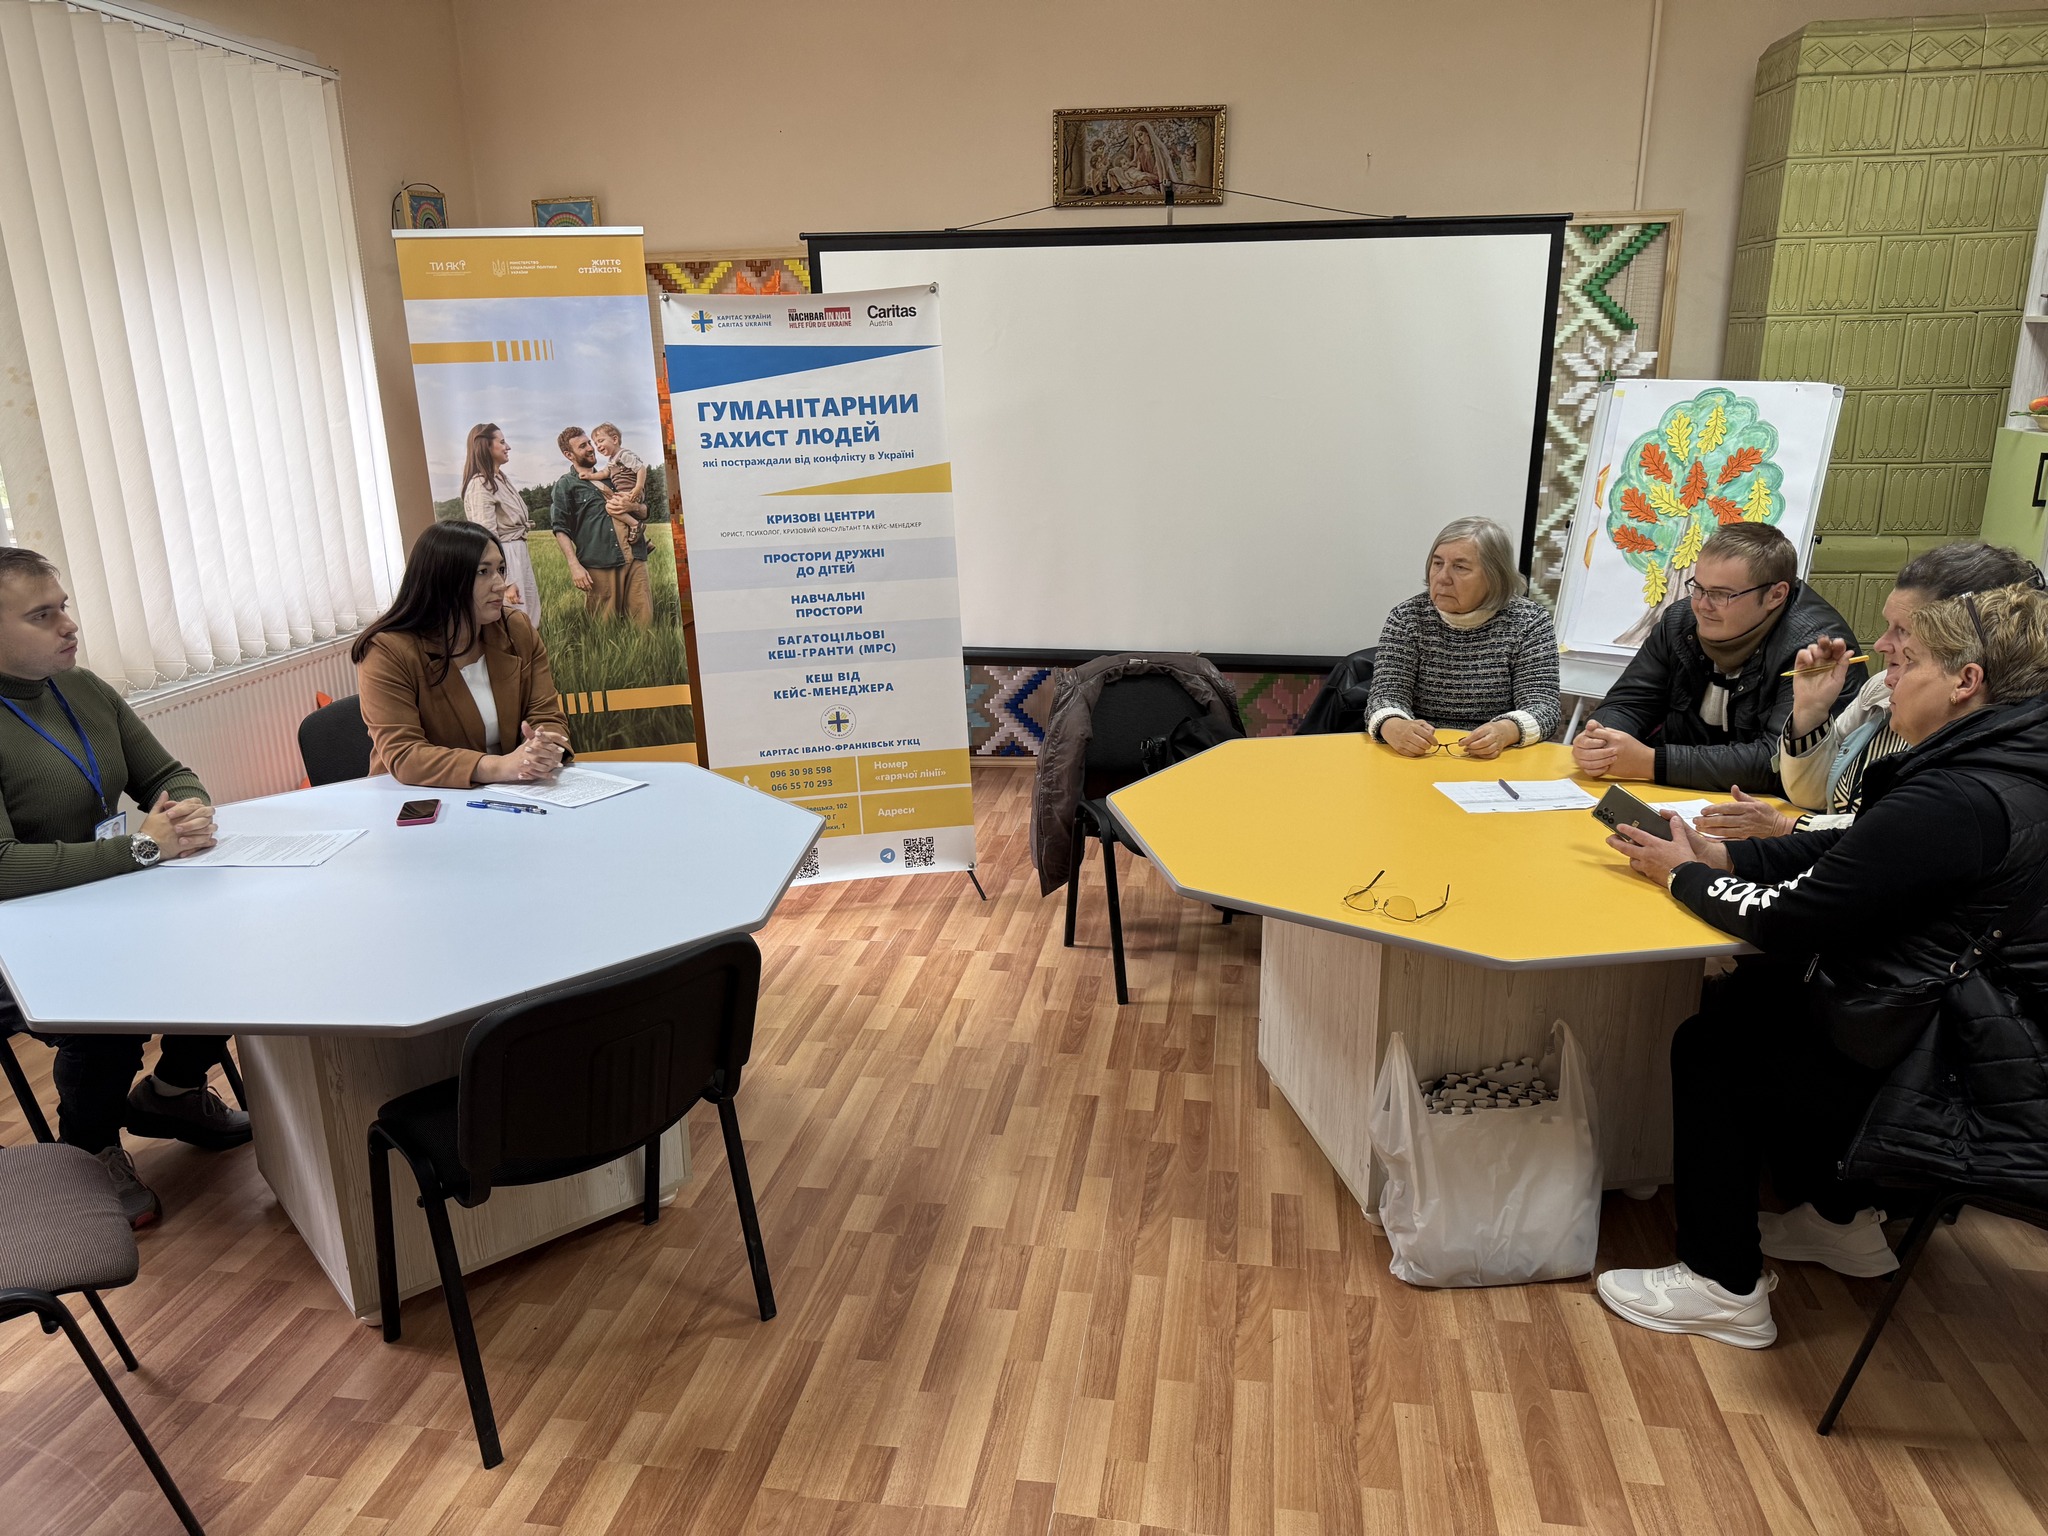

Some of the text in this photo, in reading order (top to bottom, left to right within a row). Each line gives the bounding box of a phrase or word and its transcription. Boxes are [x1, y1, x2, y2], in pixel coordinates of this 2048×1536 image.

[429, 260, 466, 271] ТИ ЯК?
[788, 311, 824, 321] NACHBAR
[868, 305, 917, 318] Caritas
[701, 421, 880, 449] ЗАХИСТ ЛЮДЕЙ
[703, 459, 718, 468] які
[721, 456, 791, 468] постраждали
[795, 453, 810, 465] від
[813, 451, 866, 464] конфлікту
[878, 449, 914, 461] Україні
[766, 510, 875, 524] КРИЗОВІ ЦЕНТРИ
[720, 530, 745, 538] ЮРИСТ,
[783, 526, 816, 534] КРИЗОВИЙ
[871, 522, 922, 530] КЕЙС-МЕНЕДЖЕР
[764, 548, 884, 563] ПРОСТОРИ ДРУЖНІ
[796, 563, 855, 578] ДО ДІТЕЙ
[791, 591, 865, 604] НАВЧАЛЬНІ
[796, 605, 862, 618] ПРОСТОРИ
[778, 630, 885, 646] БАГАТОЦІЛЬОВІ
[769, 642, 896, 660] КЕШ-ГРАНТИ (МРС)
[806, 671, 860, 684] КЕШ ВІД
[773, 683, 893, 700] КЕЙС-МЕНЕДЖЕРА
[760, 738, 920, 757] КАРІТАС ІВАНО-ФРАНКІВСЬК УГКЦ
[874, 760, 908, 770] Номер
[770, 766, 831, 778] 096 30 98 598
[875, 769, 946, 782] «гарячої лінії»
[771, 779, 833, 791] 066 55 70 293
[878, 806, 915, 817] Адреси
